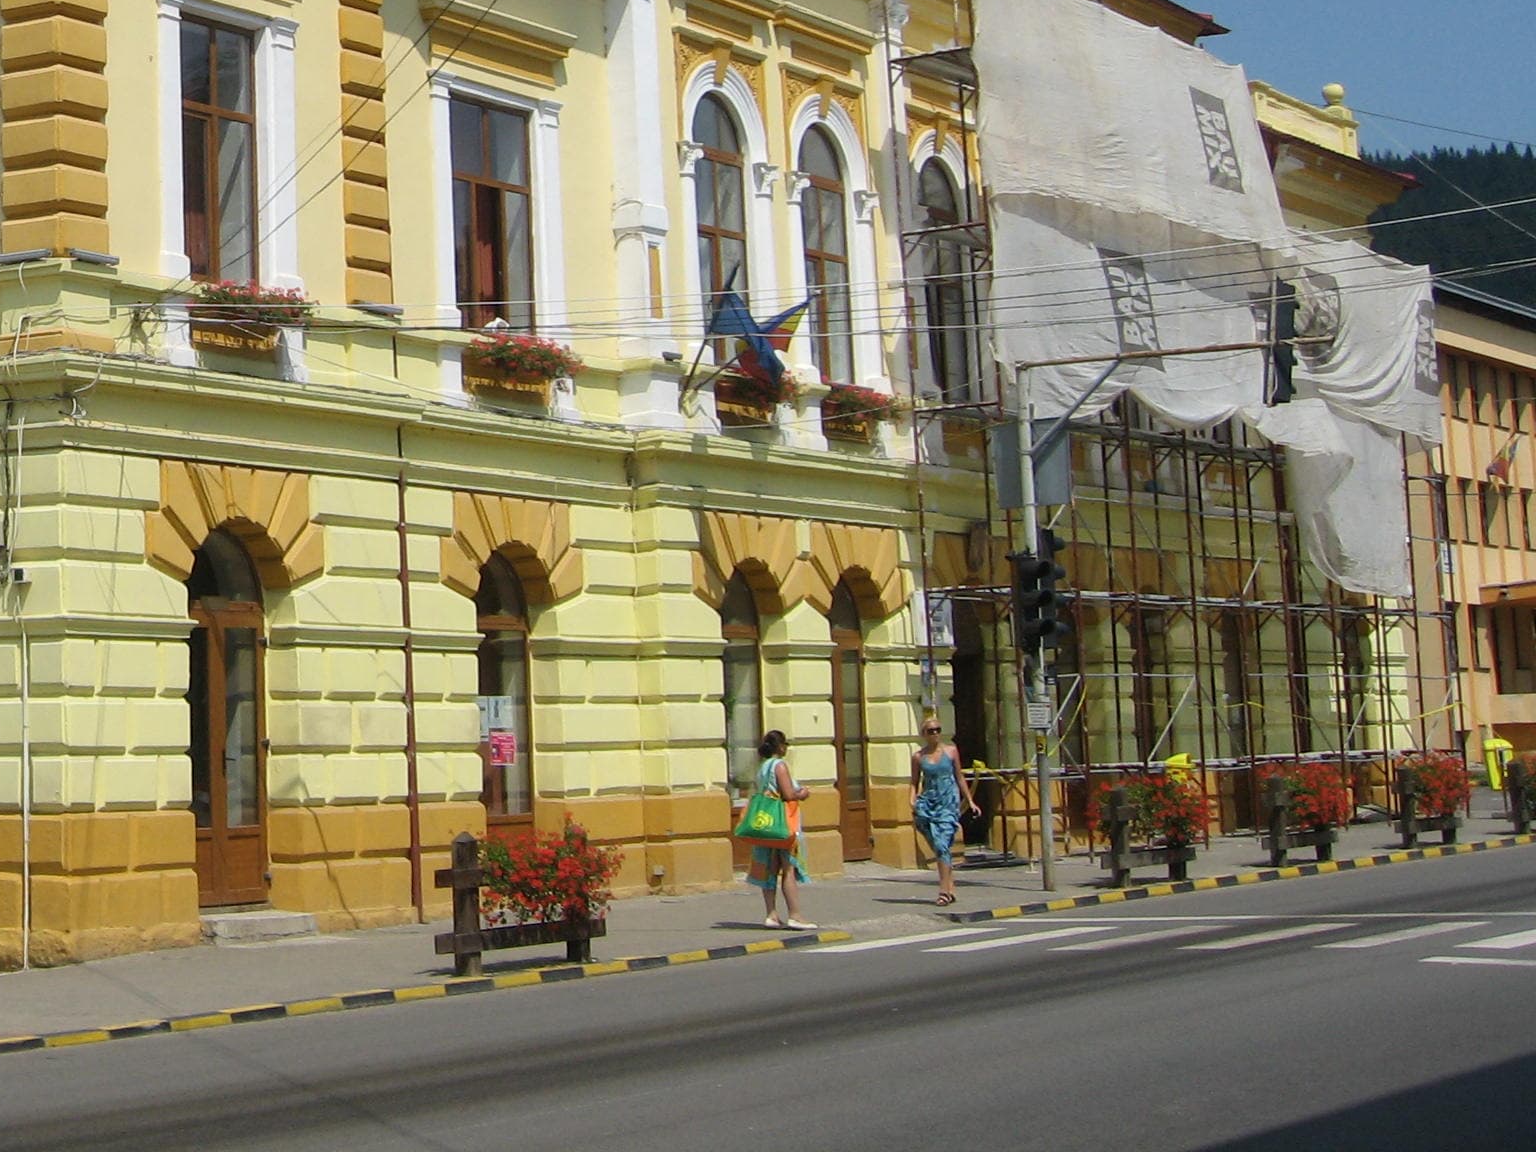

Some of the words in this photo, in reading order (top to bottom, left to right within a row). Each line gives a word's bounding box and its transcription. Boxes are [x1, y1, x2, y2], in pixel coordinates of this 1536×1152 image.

[1195, 104, 1225, 173] MIX
[1210, 110, 1240, 179] BAU
[1415, 314, 1431, 377] MIX
